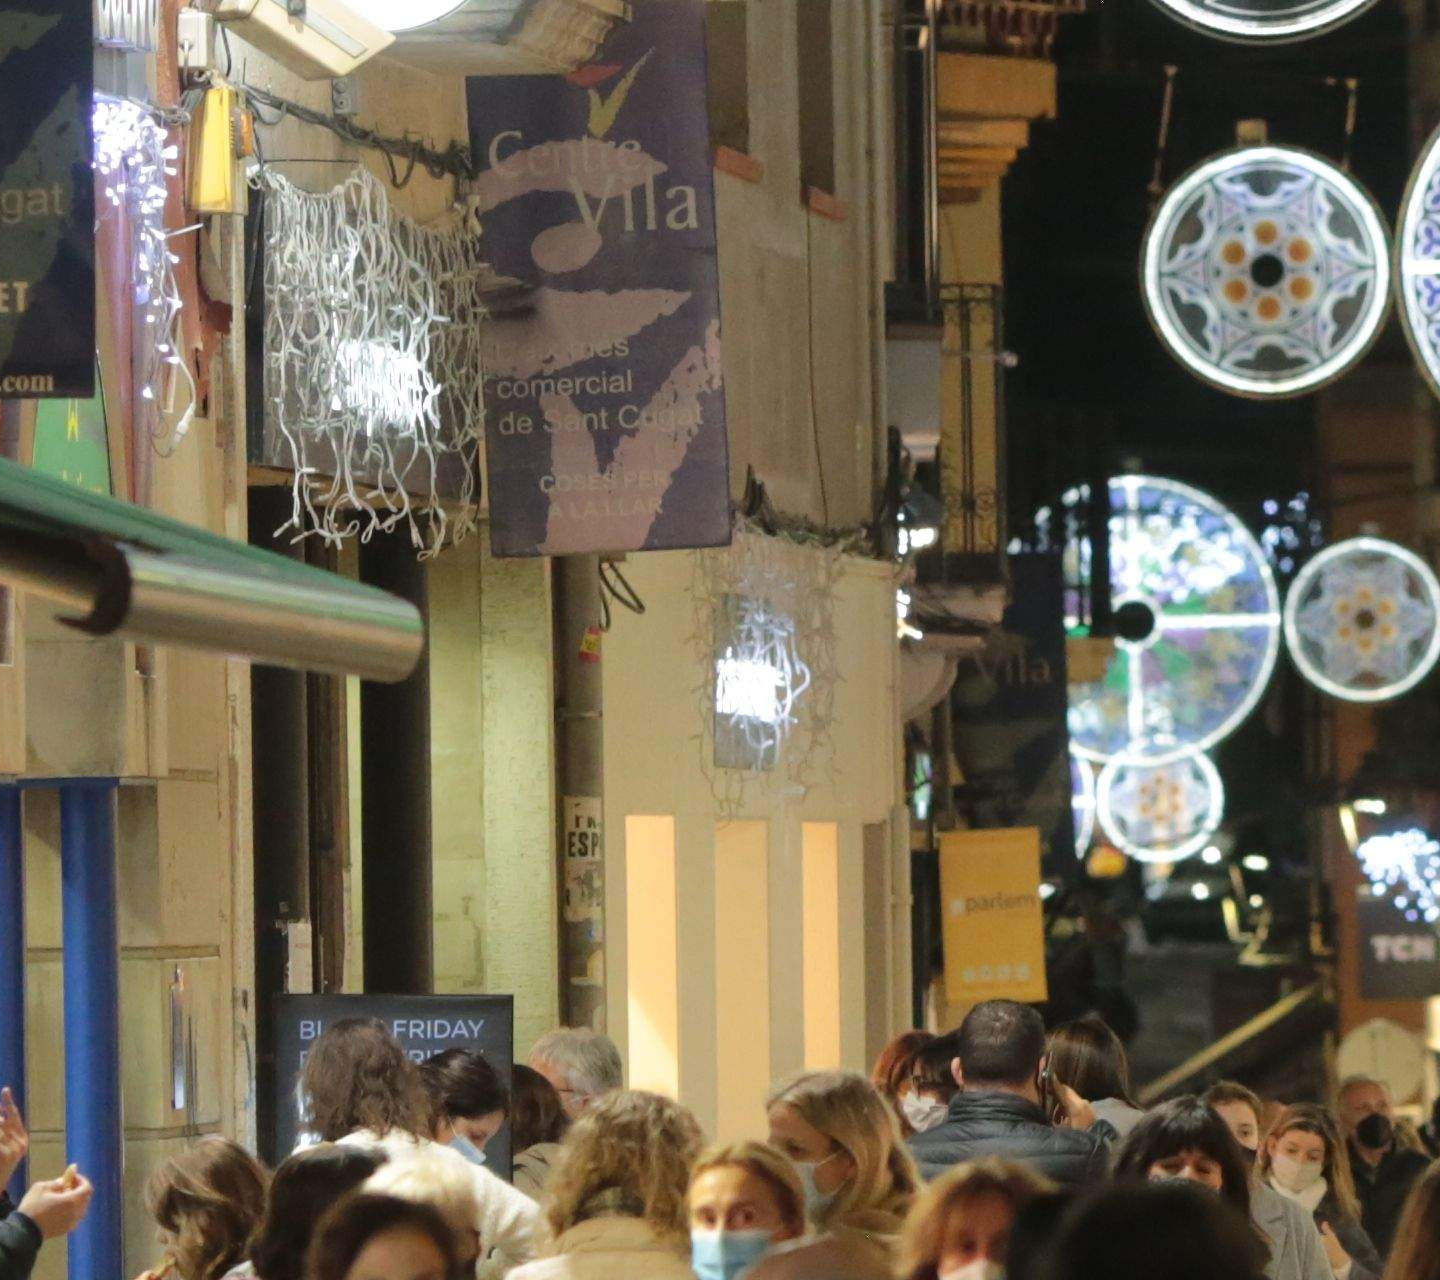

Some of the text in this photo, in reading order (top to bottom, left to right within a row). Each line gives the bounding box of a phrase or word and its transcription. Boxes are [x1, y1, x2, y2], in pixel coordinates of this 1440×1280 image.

[489, 130, 643, 177] Centre
[567, 170, 698, 231] Vila
[496, 370, 633, 399] comercial
[499, 401, 704, 436] de Sant Cugat
[392, 1020, 485, 1039] FRIDAY
